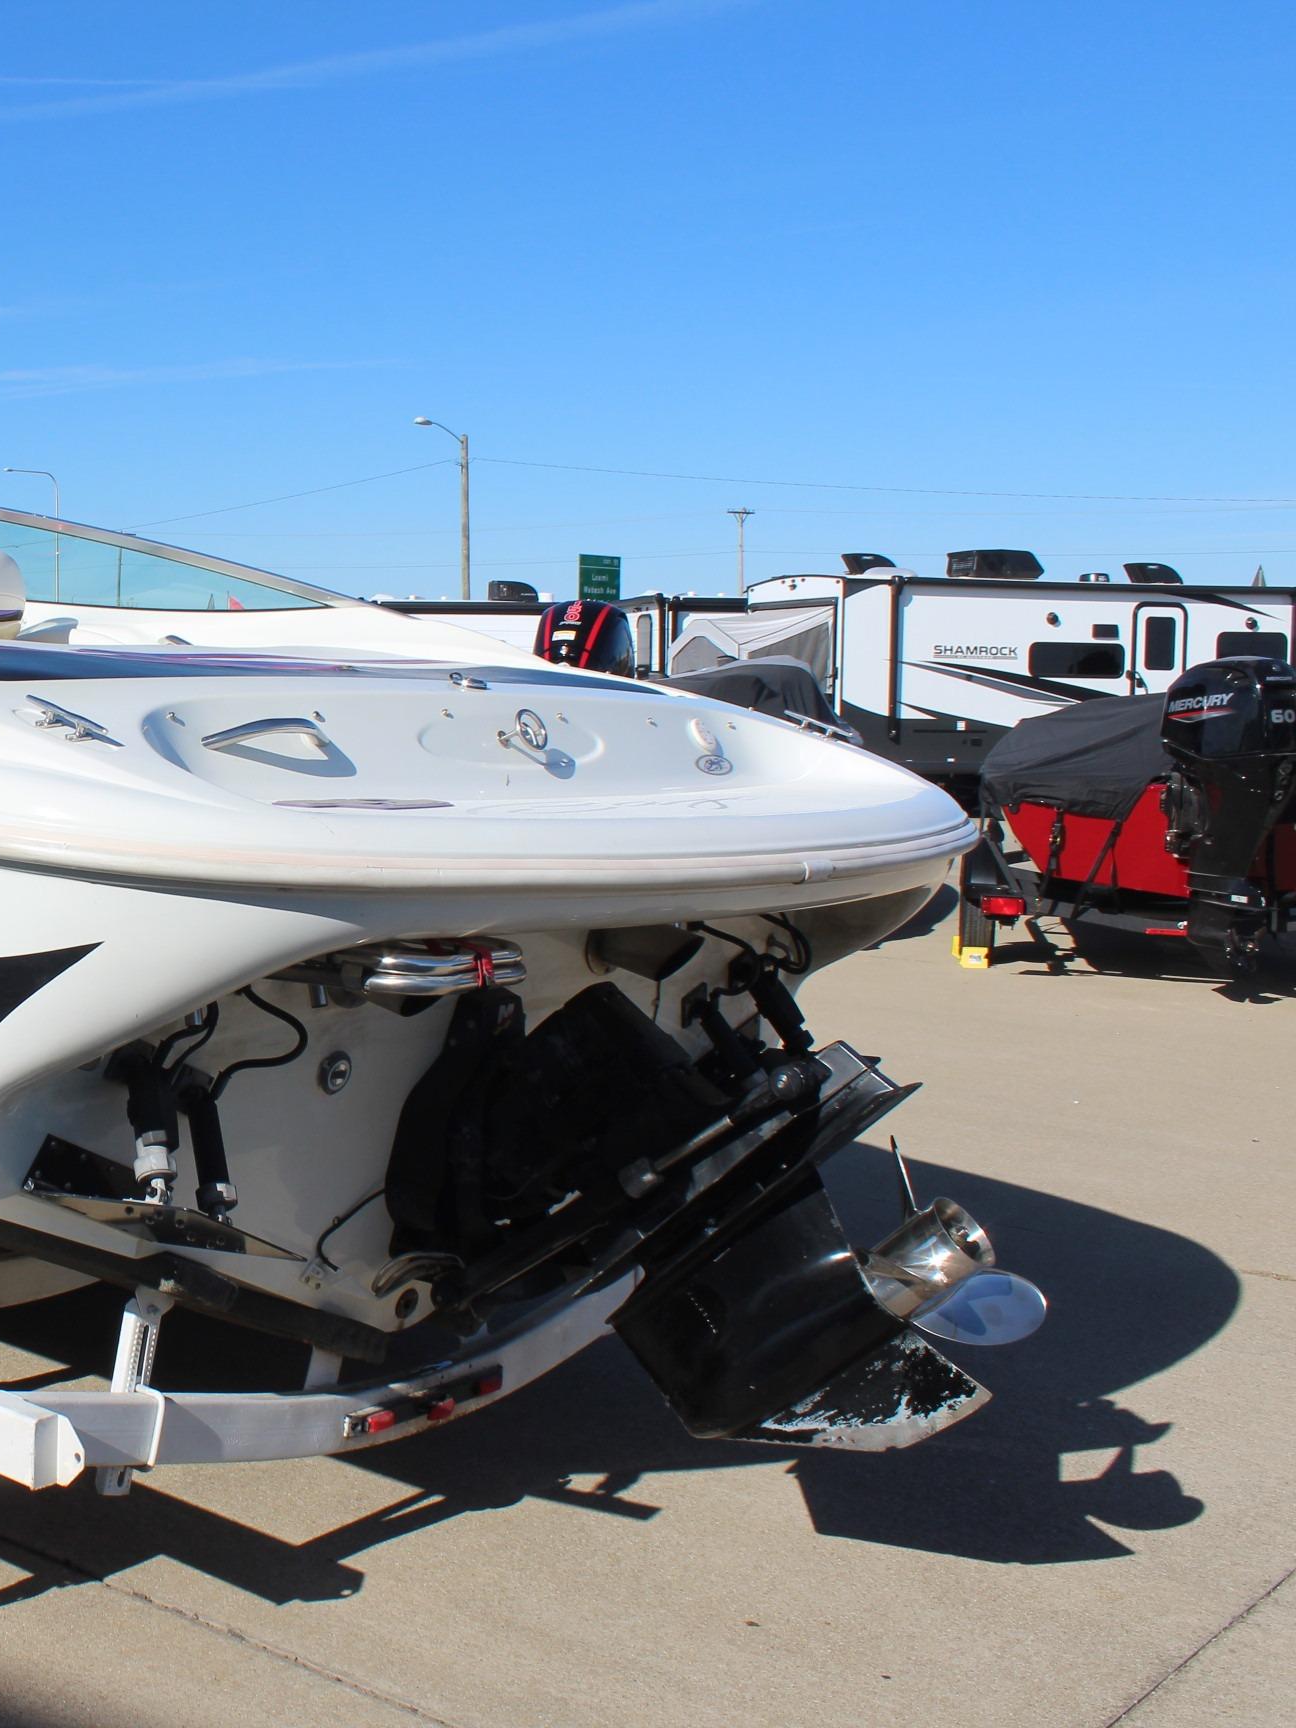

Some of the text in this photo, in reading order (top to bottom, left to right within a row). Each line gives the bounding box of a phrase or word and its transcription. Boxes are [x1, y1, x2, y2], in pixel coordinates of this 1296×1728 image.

[933, 645, 1018, 656] SHAMROCK
[1168, 692, 1235, 713] MERCURY
[1270, 709, 1296, 724] 60
